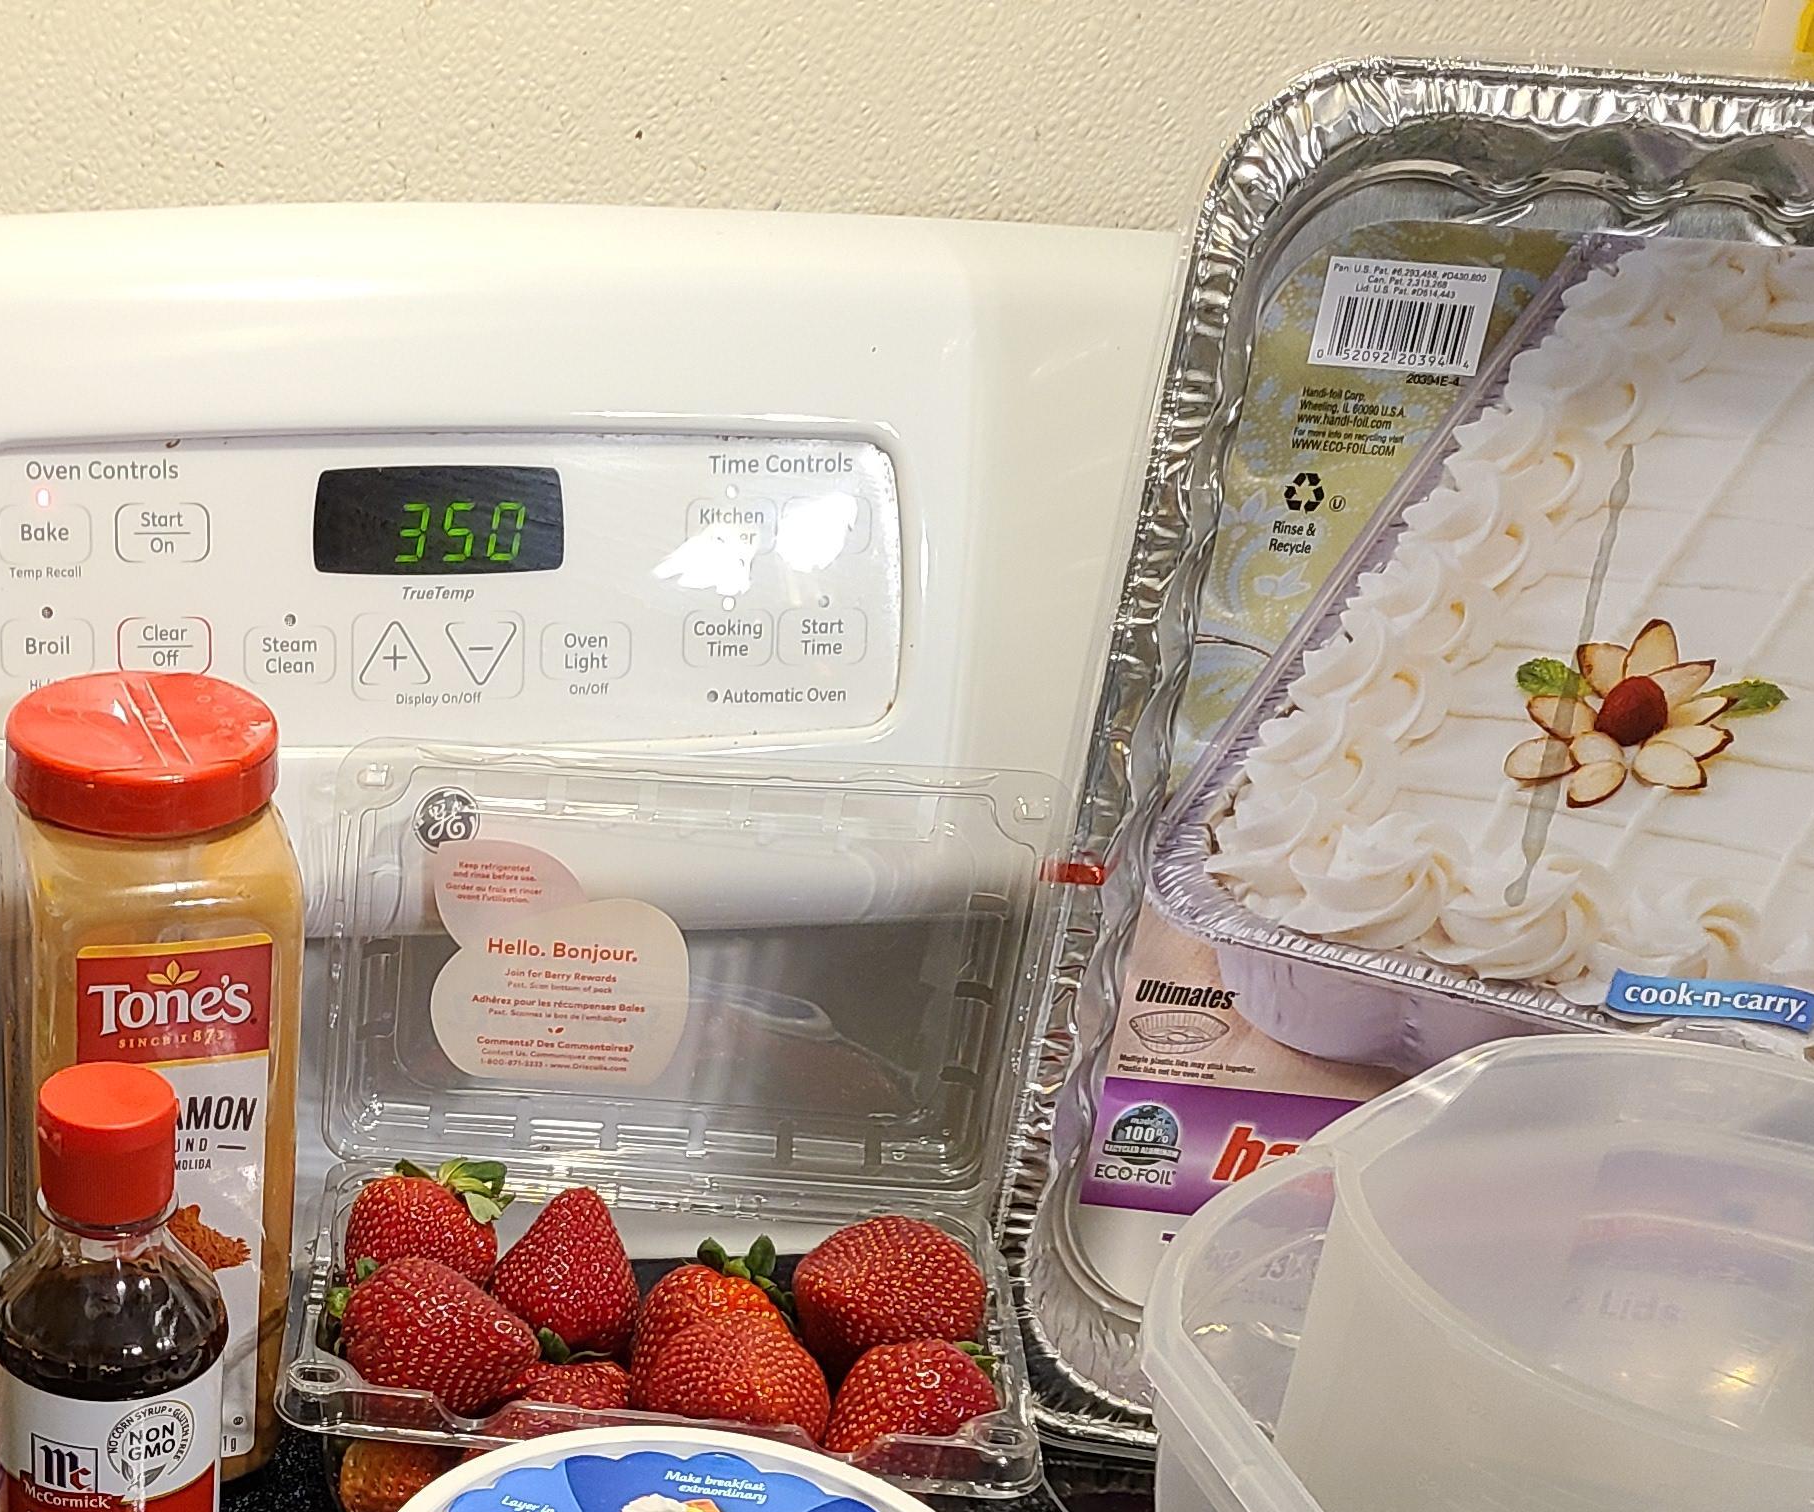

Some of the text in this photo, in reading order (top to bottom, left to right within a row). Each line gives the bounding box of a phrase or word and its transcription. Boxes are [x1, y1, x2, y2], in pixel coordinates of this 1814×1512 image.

[1342, 349, 1446, 368] 52092 20394
[26, 458, 179, 480] Oven Controls
[708, 452, 853, 474] Time Controls
[140, 511, 184, 527] Start
[699, 508, 765, 525] Kitchen
[20, 521, 70, 542] Bake
[394, 502, 526, 563] 350
[1272, 520, 1317, 537] Rinse &
[150, 537, 175, 553] On
[1268, 538, 1312, 556] Recycle
[9, 565, 82, 580] Temp Recall
[402, 586, 475, 602] TrueTemp
[142, 623, 188, 641] Clear
[693, 618, 764, 640] Cooking
[801, 618, 845, 635] Start
[25, 636, 71, 656] Broil
[261, 636, 318, 653] Steam
[563, 632, 609, 648] Oven
[706, 641, 749, 657] Time
[800, 639, 843, 655] Time
[152, 650, 180, 667] Off
[265, 657, 316, 675] Clean
[564, 652, 609, 672] Light
[568, 682, 610, 696] On/Off
[722, 688, 847, 704] Automatic Oven
[395, 692, 482, 707] Display On/Off
[487, 937, 638, 964] Hello. Bonjour.
[574, 972, 617, 983] Rewards
[1134, 979, 1235, 1010] Ultimates
[118, 1026, 225, 1049] SINCE 1873
[1124, 1125, 1169, 1144] 100%
[134, 1405, 167, 1421] SYRUP
[129, 1421, 175, 1446] NON
[127, 1438, 176, 1462] GMO
[664, 1470, 766, 1492] Make breakfast
[23, 1479, 111, 1510] McCormick
[678, 1482, 767, 1505] extraordinary
